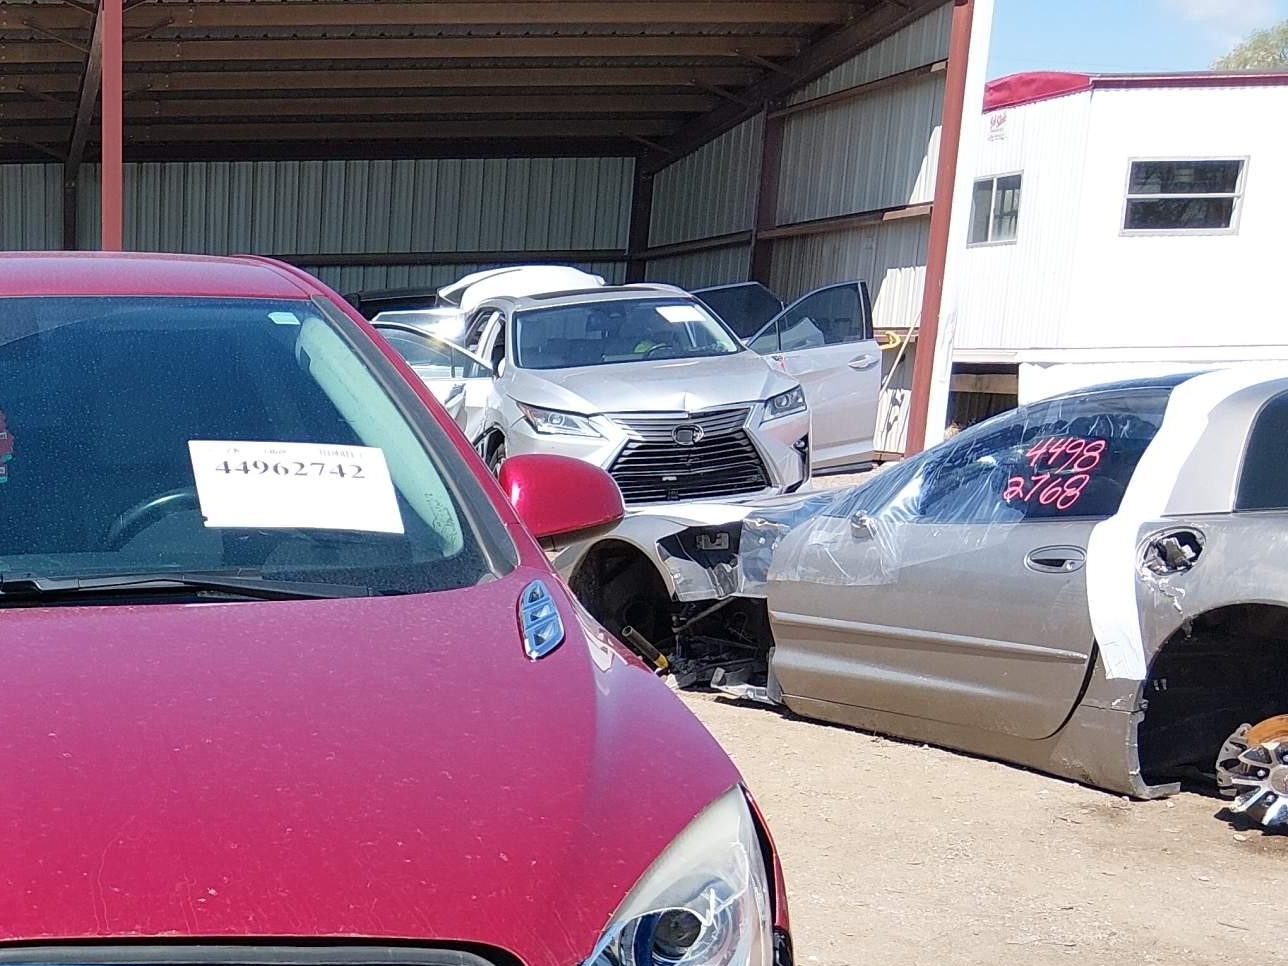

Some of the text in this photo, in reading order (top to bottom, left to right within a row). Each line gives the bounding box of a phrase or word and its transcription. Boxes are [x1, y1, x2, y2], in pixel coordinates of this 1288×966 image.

[215, 460, 366, 479] 44962742
[1025, 437, 1106, 472] 4498
[1003, 473, 1090, 509] 2768
